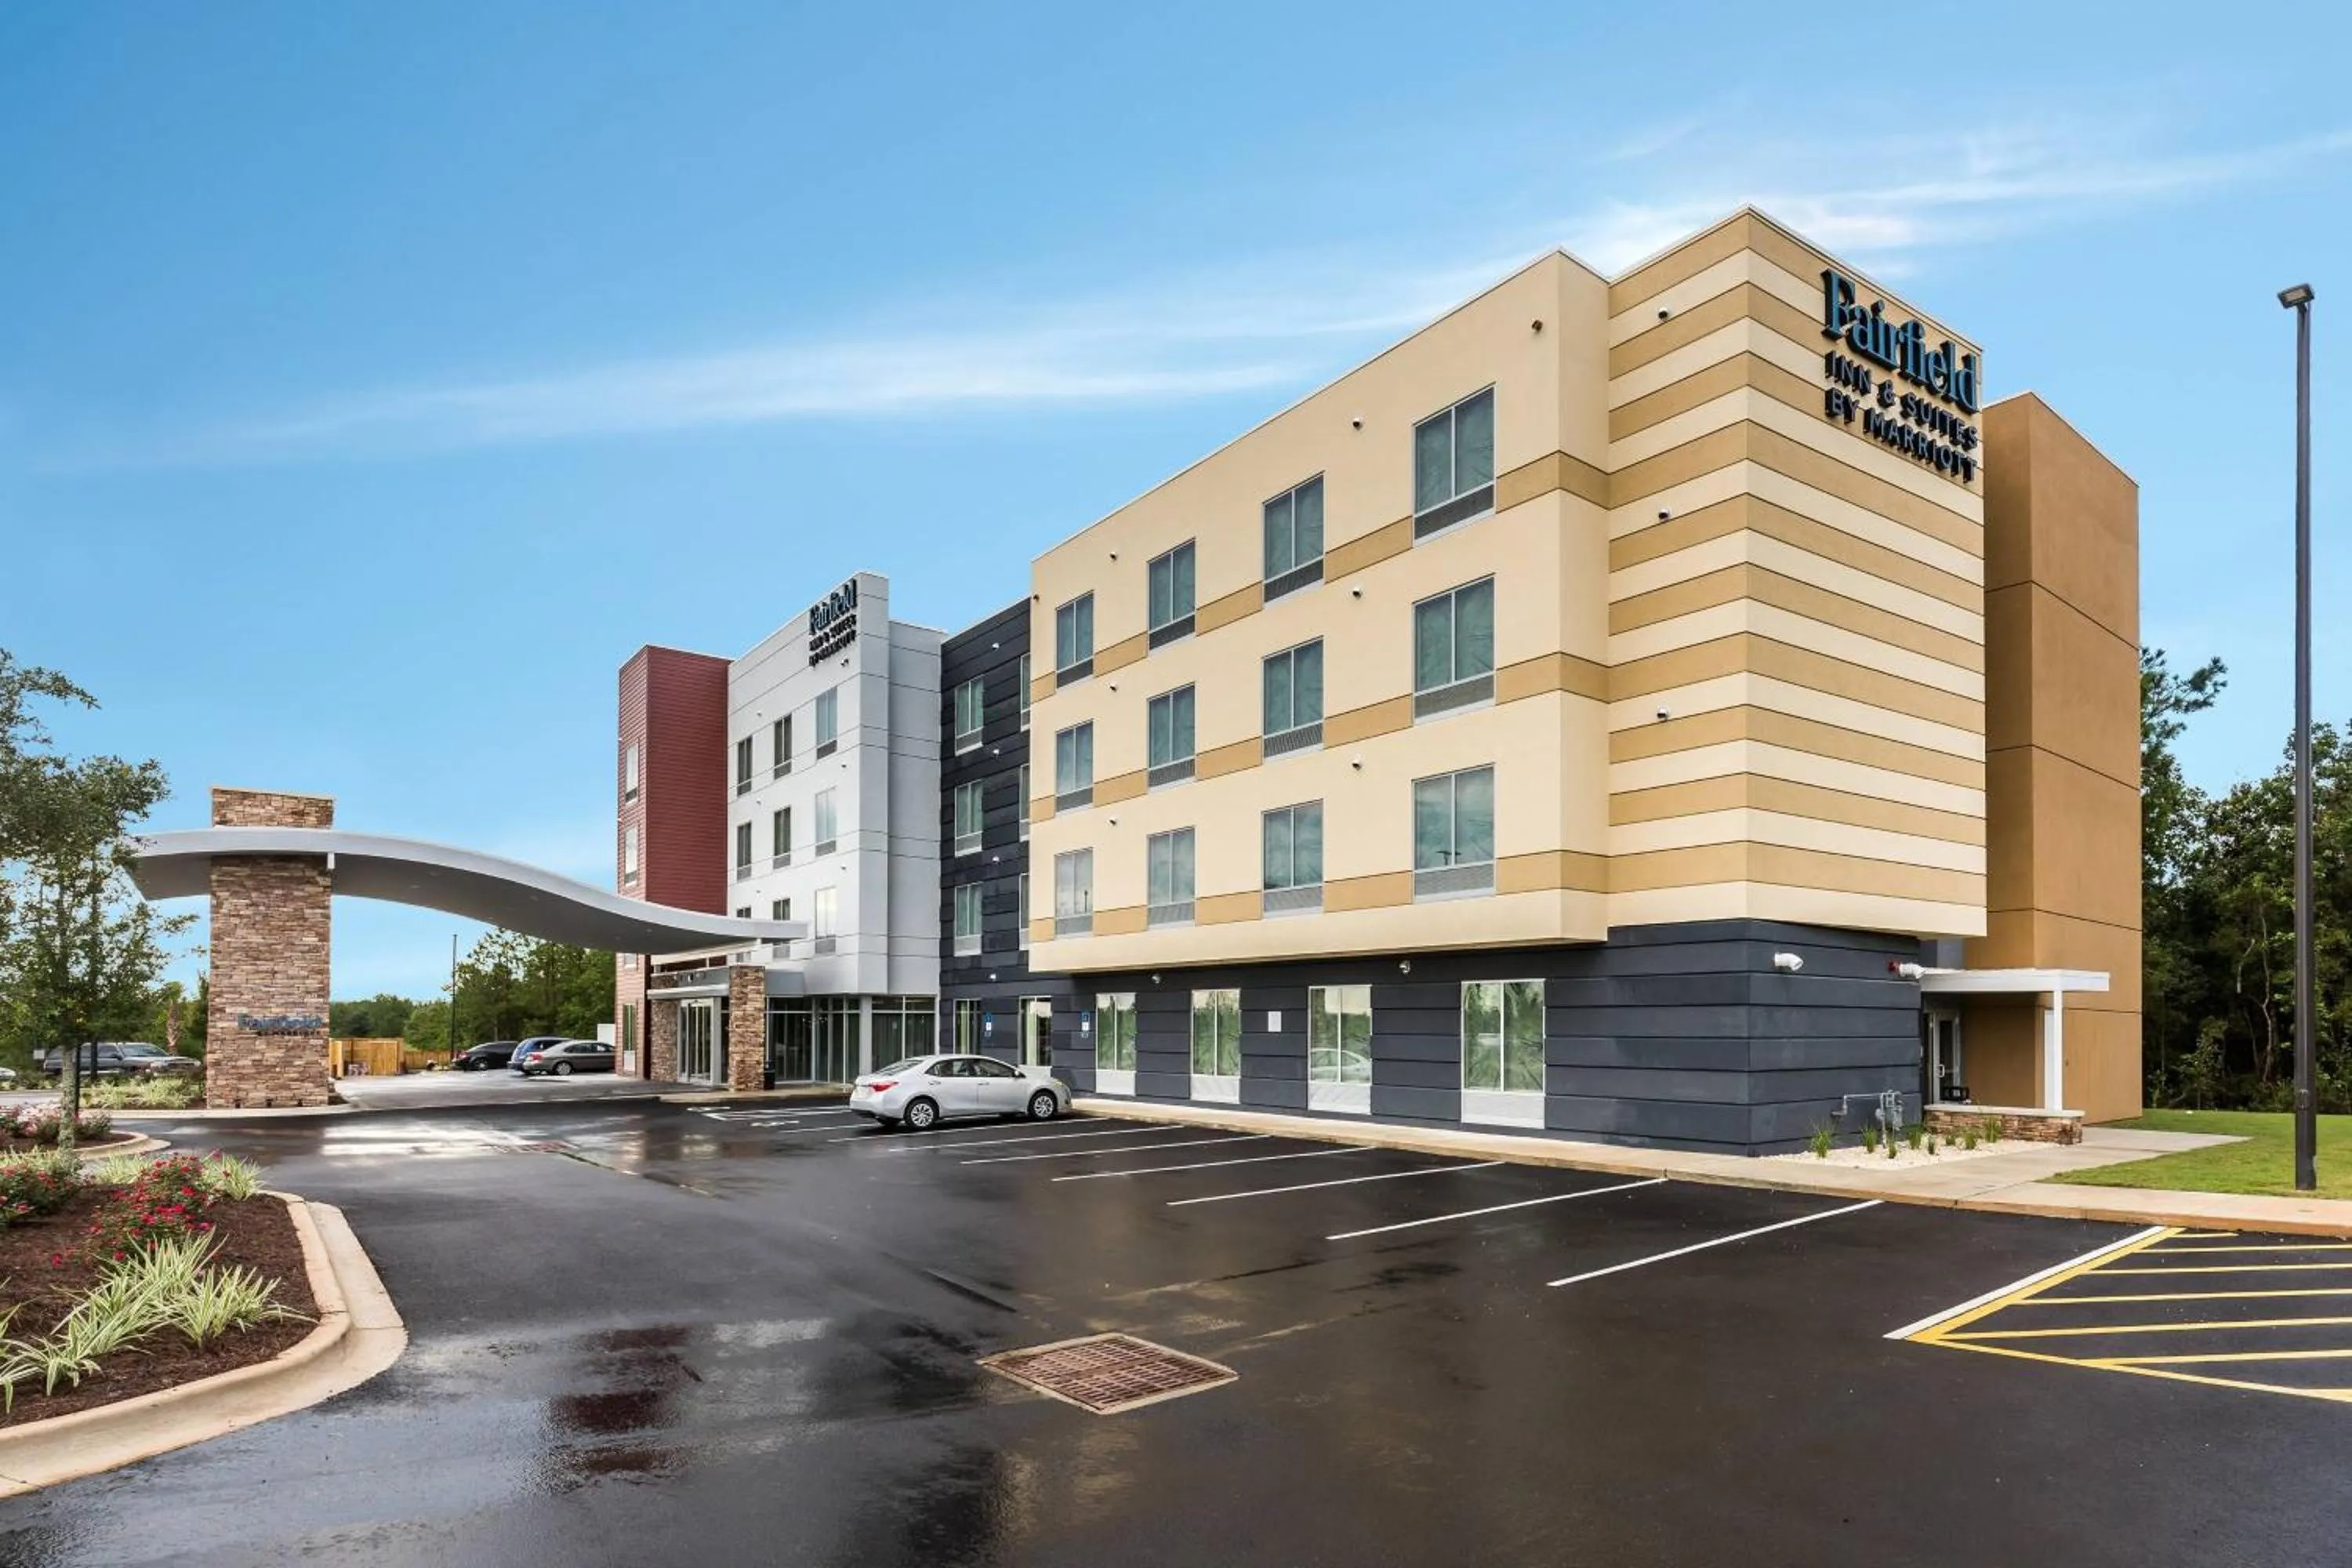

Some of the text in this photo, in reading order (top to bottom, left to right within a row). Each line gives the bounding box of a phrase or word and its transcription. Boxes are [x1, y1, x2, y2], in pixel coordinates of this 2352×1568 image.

[1820, 268, 1980, 415] Fairfield
[1824, 350, 1978, 452] INN & SUITES
[1825, 387, 1977, 483] BY MARRIOTT
